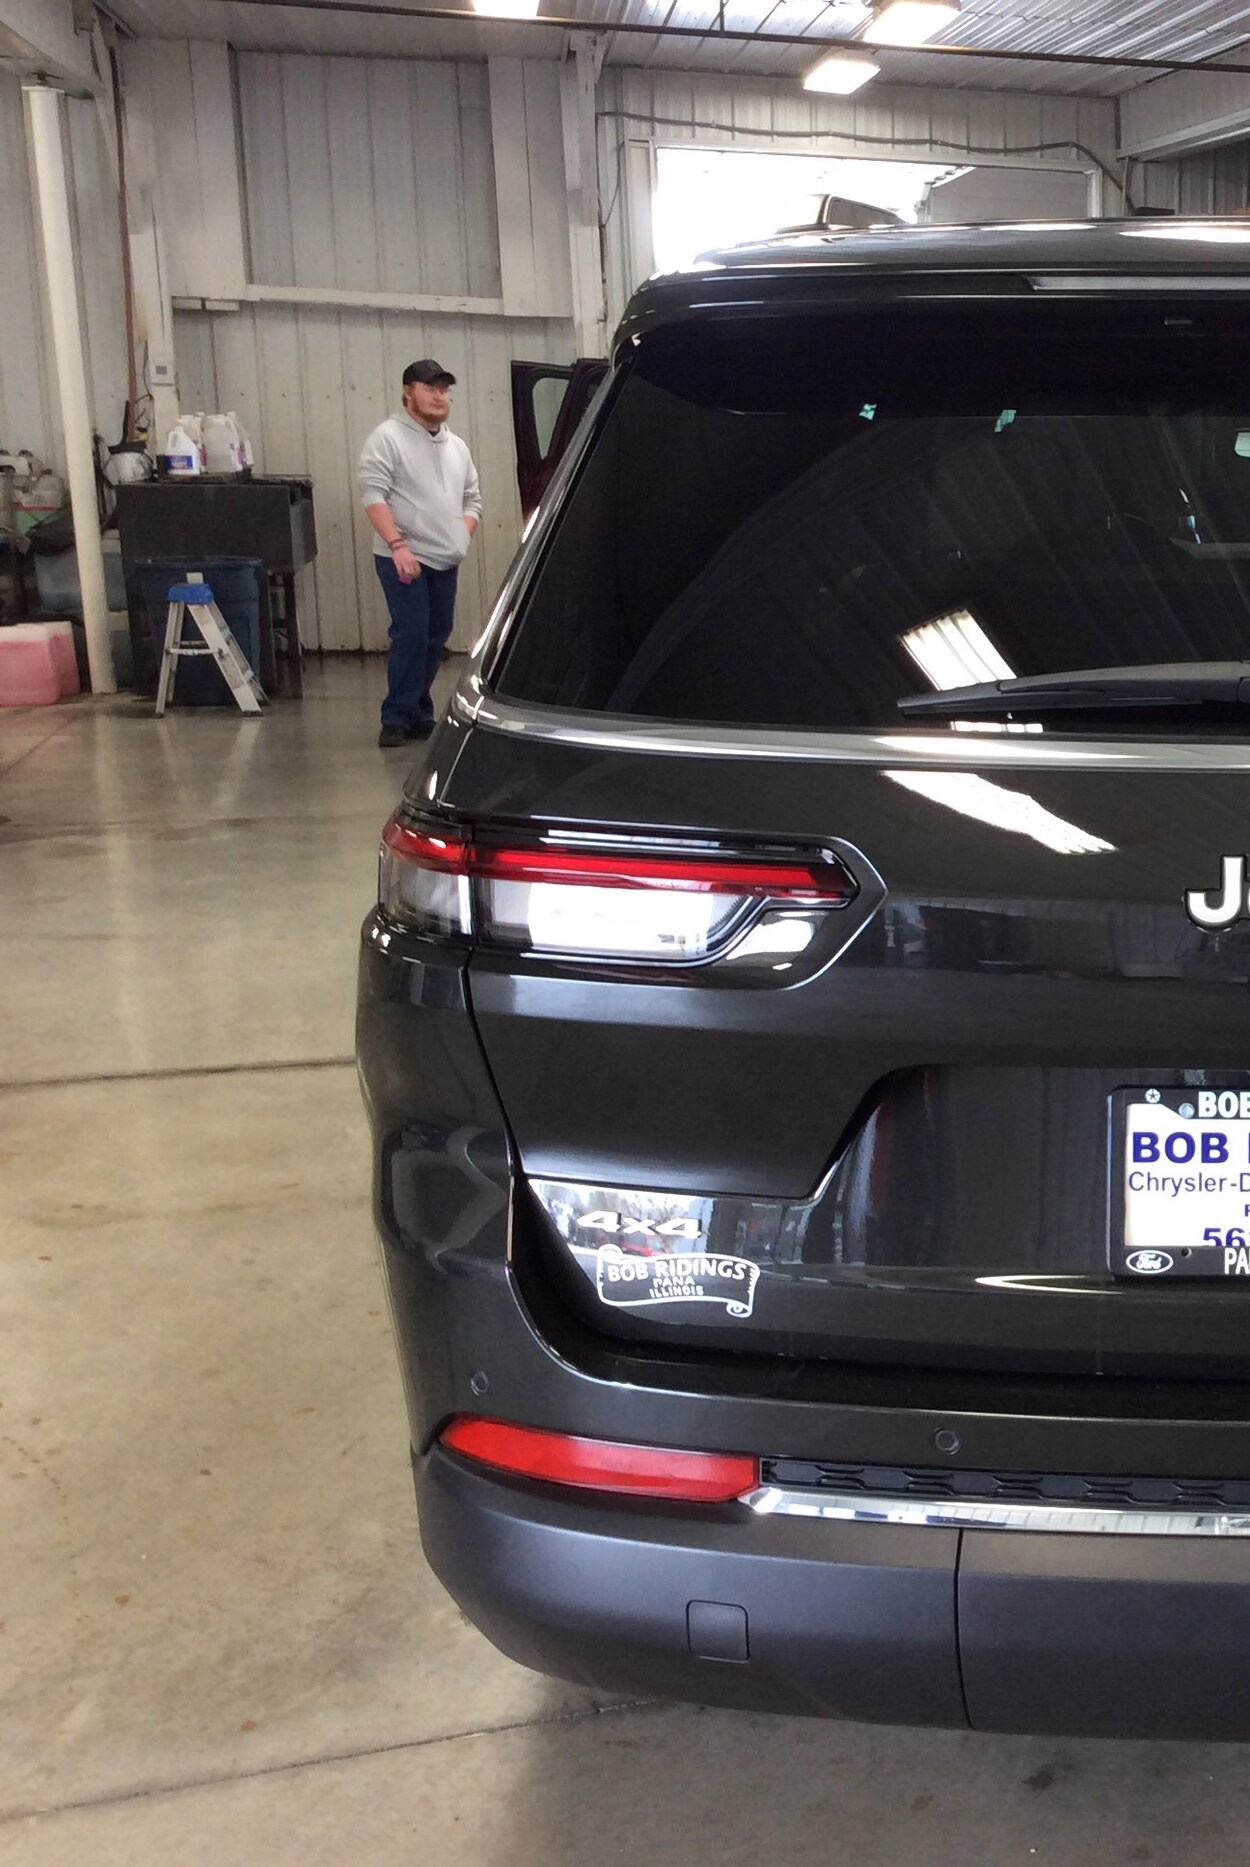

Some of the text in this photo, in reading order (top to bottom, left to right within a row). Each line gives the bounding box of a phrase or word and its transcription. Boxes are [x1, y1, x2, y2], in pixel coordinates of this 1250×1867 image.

[1132, 1131, 1230, 1165] BOB
[577, 1210, 702, 1239] 4x4
[608, 1260, 747, 1282] BOB RIDINGS
[653, 1277, 695, 1287] PANA
[649, 1286, 704, 1299] ILLINOIS
